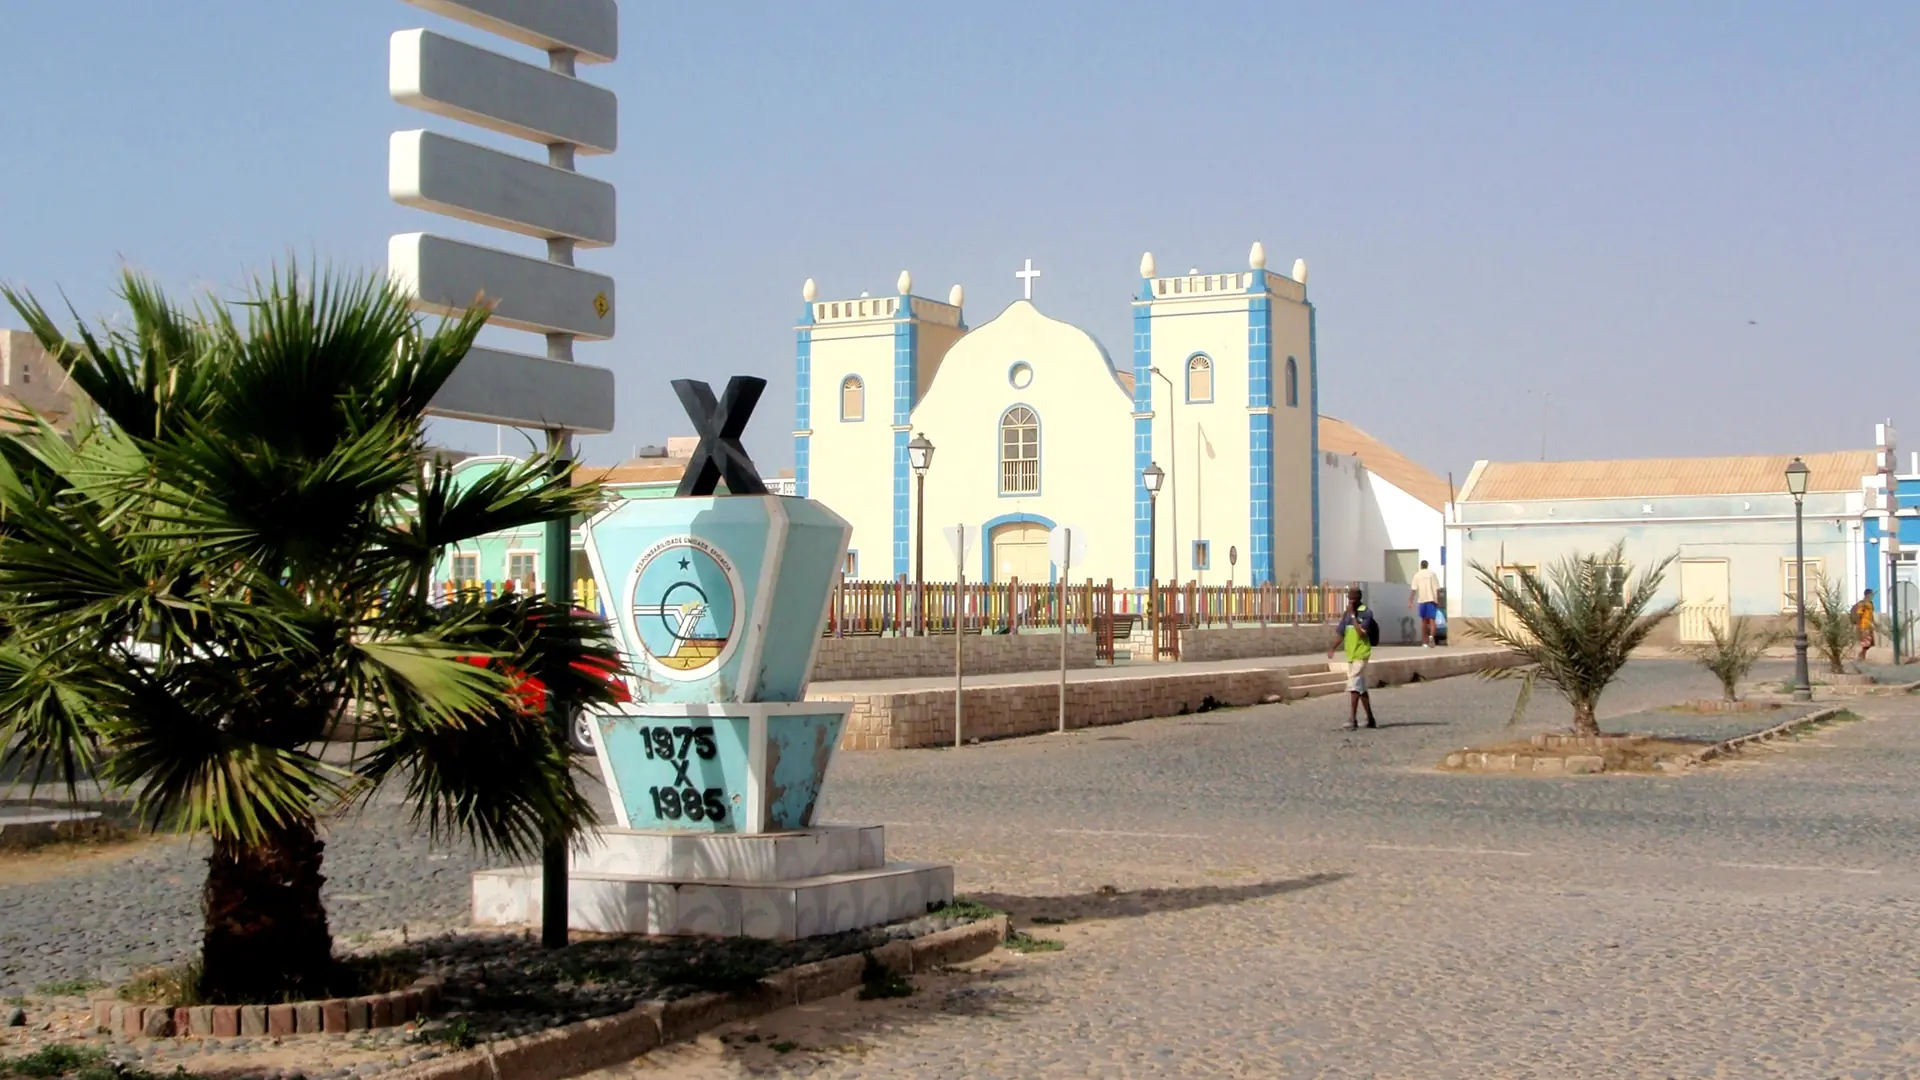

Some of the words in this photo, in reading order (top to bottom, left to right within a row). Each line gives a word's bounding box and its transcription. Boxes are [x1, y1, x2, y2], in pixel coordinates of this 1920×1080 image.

[670, 376, 769, 495] X
[639, 727, 716, 760] 1975
[669, 759, 694, 788] X
[649, 786, 726, 821] 1985
